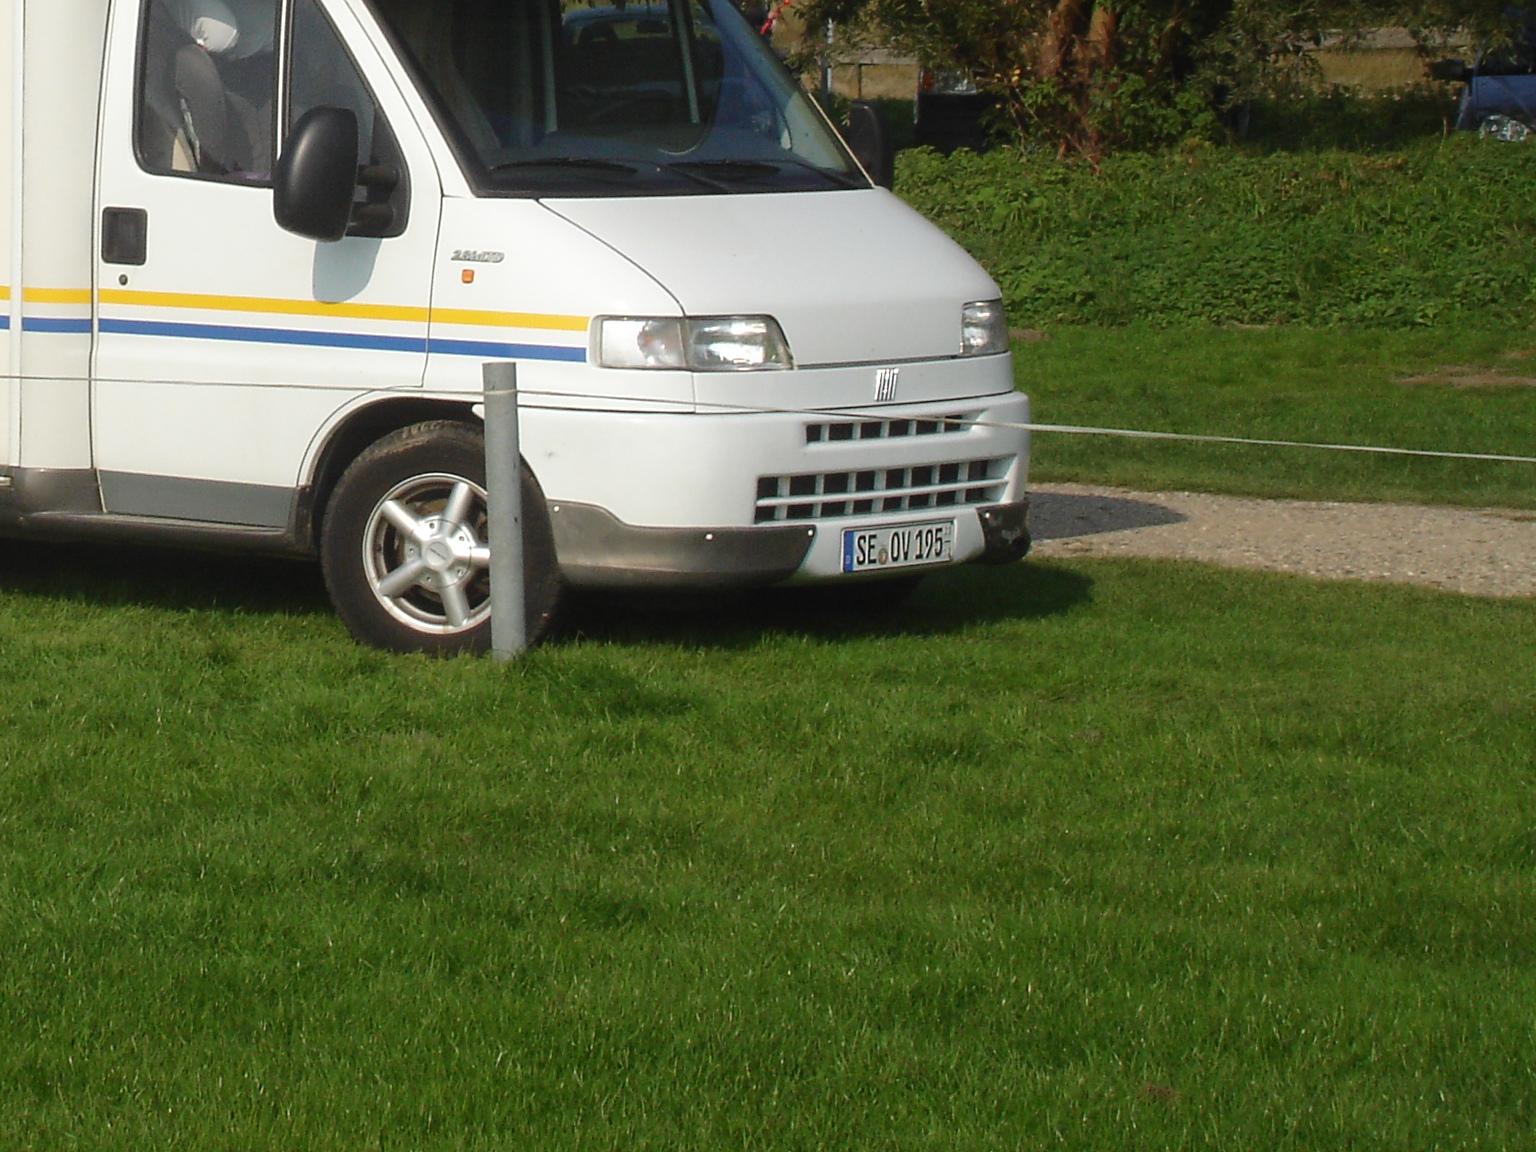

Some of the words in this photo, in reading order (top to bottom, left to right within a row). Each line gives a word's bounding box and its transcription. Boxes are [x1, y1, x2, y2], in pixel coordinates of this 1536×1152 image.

[856, 534, 877, 566] SE
[890, 530, 911, 562] OV
[915, 528, 943, 559] 195
